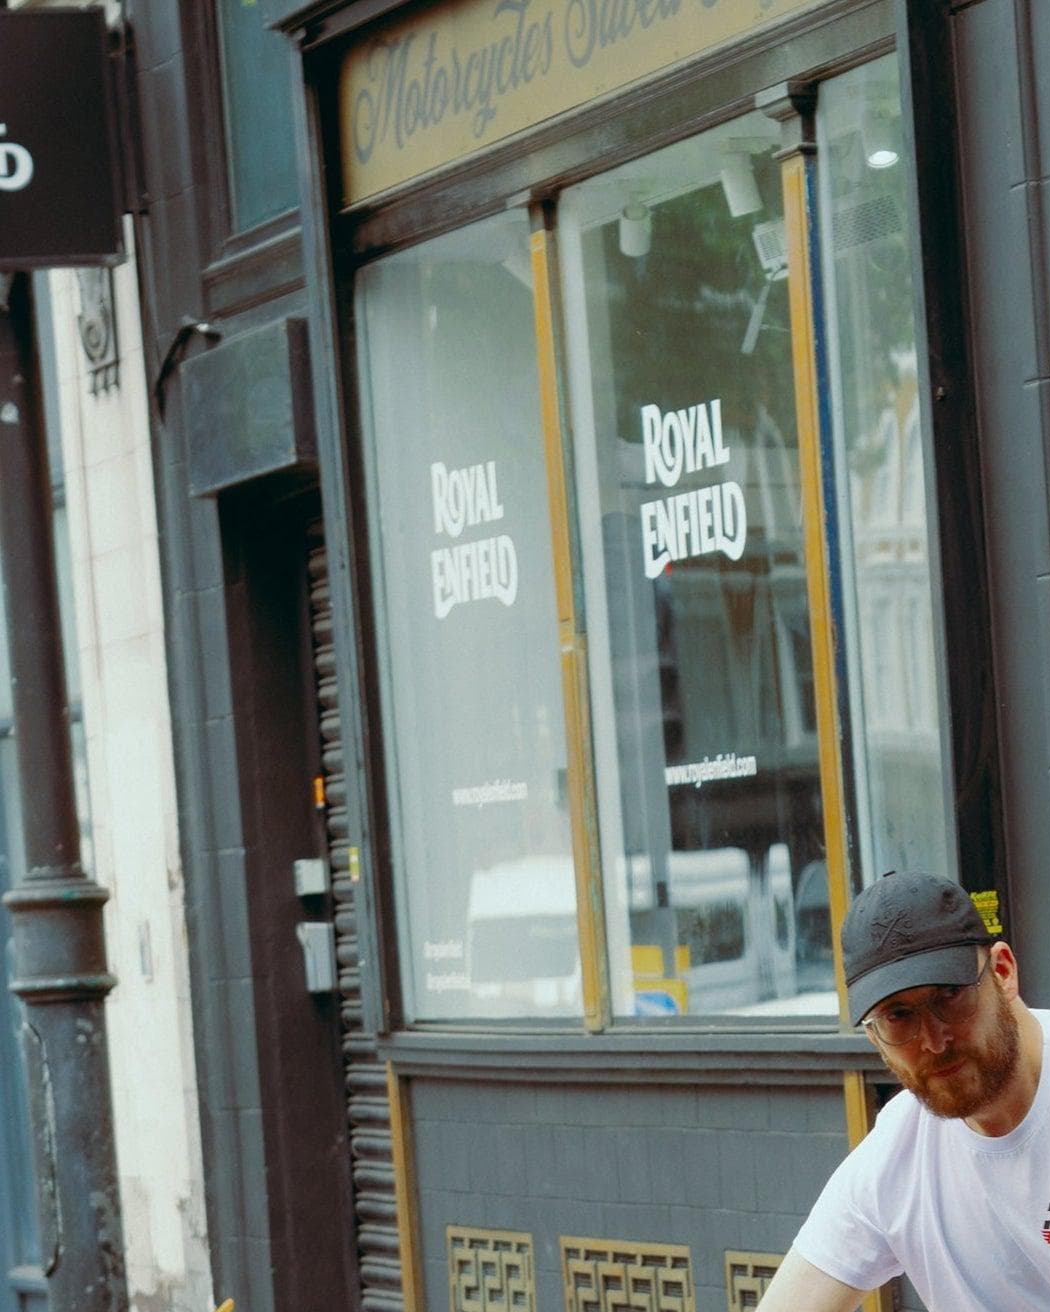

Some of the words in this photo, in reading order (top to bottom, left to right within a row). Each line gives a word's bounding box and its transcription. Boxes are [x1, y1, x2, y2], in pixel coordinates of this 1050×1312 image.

[355, 0, 554, 164] Motorcycles
[641, 399, 730, 487] ROYAL
[430, 460, 504, 538] ROYAL
[641, 482, 746, 579] ENFIELD
[430, 534, 518, 619] ENFIELD
